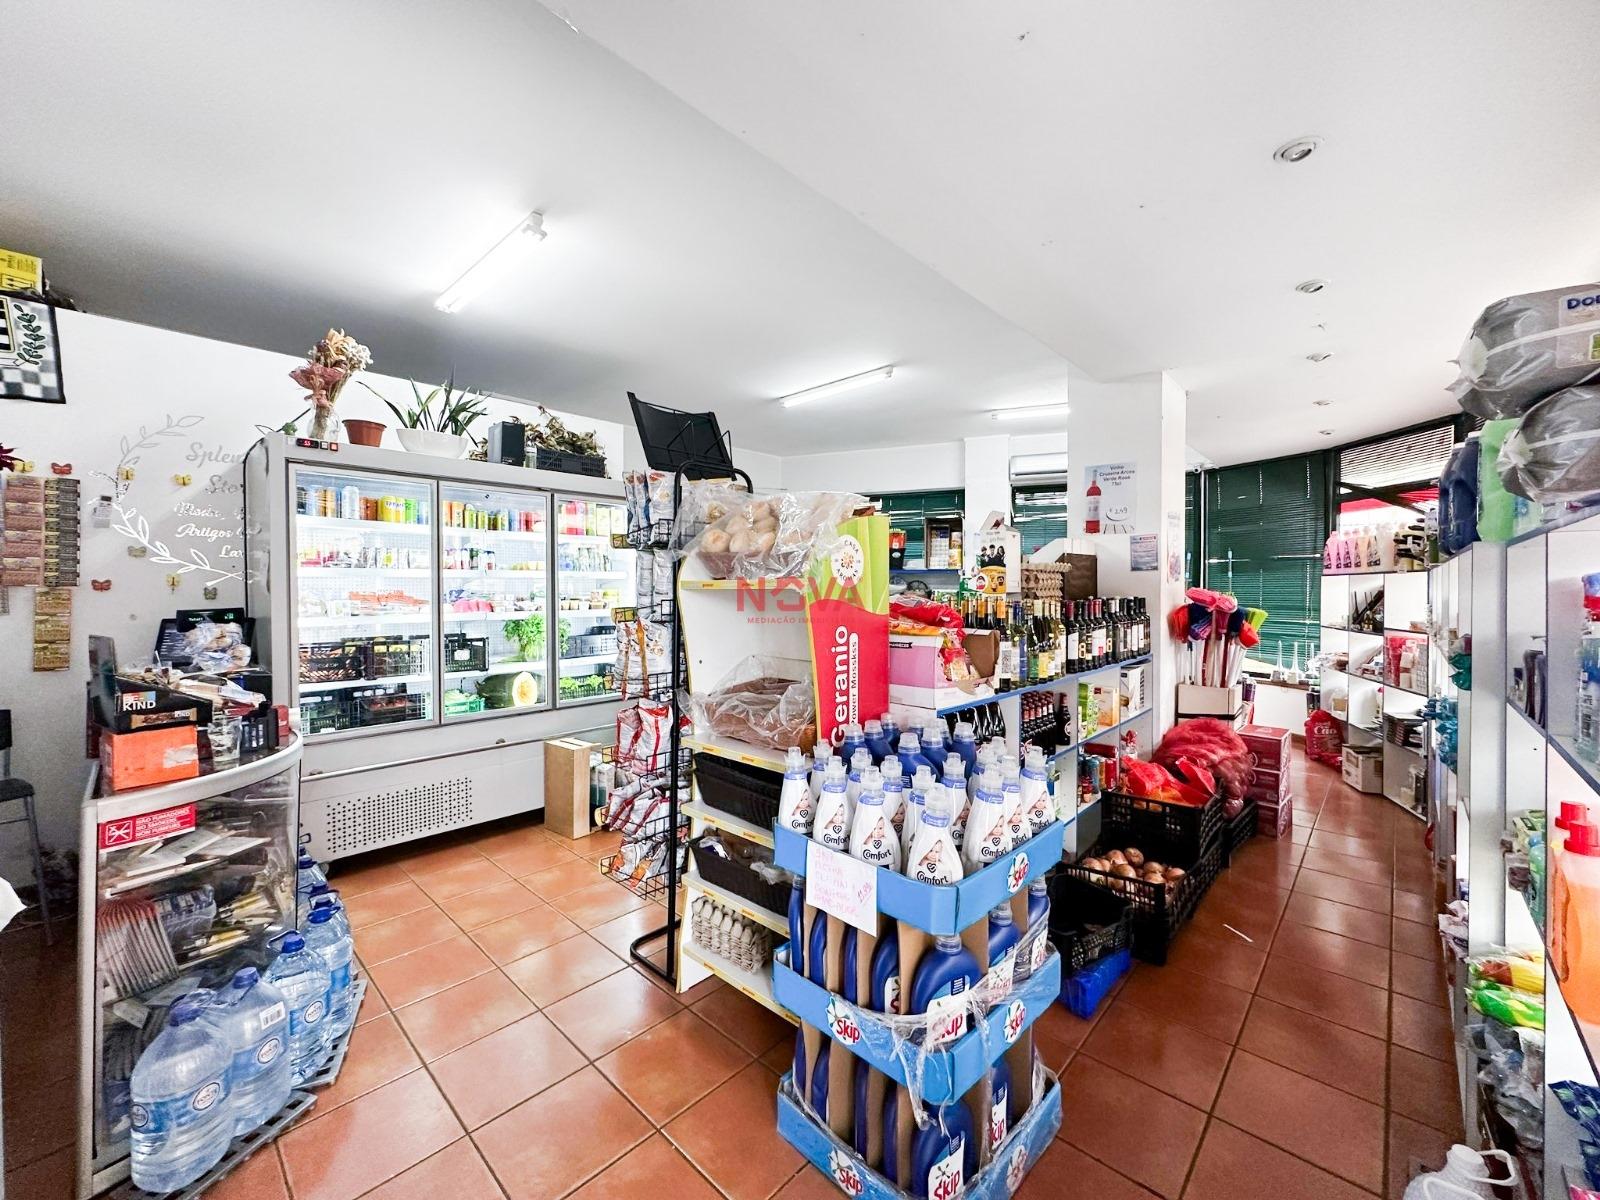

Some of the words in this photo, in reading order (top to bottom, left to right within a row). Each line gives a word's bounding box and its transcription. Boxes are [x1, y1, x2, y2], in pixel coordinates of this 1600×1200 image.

[831, 625, 848, 748] Geranio
[122, 700, 157, 712] KIND
[862, 849, 892, 861] Comfort
[916, 870, 949, 886] Comfort
[836, 1019, 861, 1043] Skip
